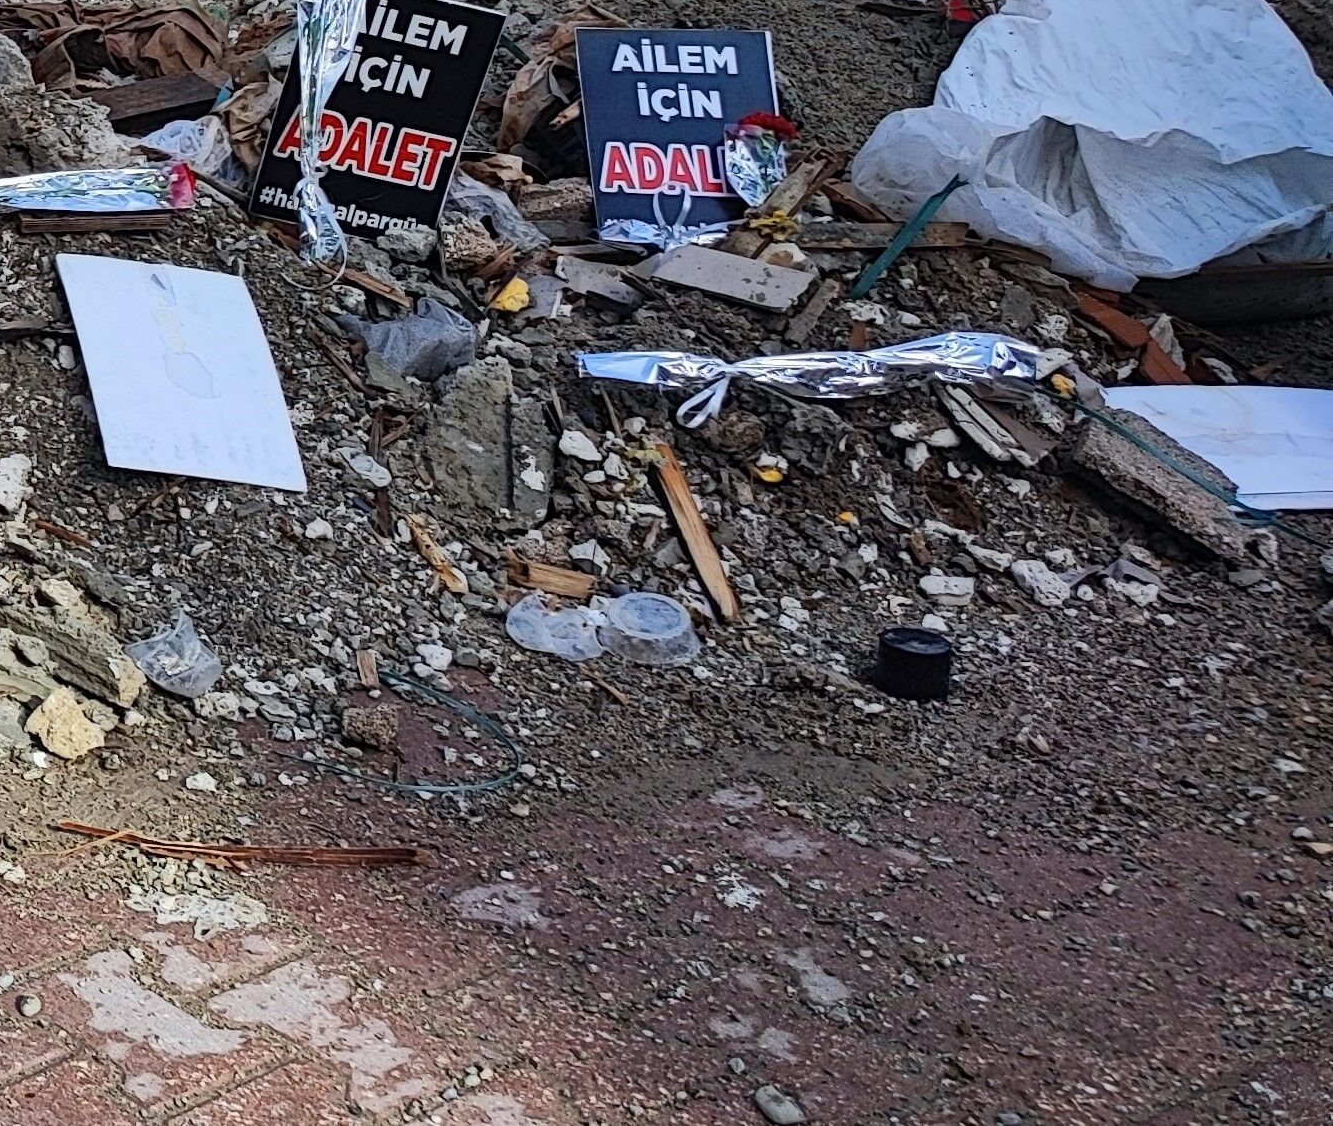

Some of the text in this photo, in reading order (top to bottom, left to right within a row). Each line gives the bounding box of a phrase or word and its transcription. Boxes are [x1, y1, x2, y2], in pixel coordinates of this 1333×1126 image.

[355, 0, 468, 56] İLEM
[344, 45, 431, 99] İÇİN
[612, 38, 739, 75] AİLEM
[637, 82, 724, 123] İÇİN
[599, 141, 731, 197] ADAL
